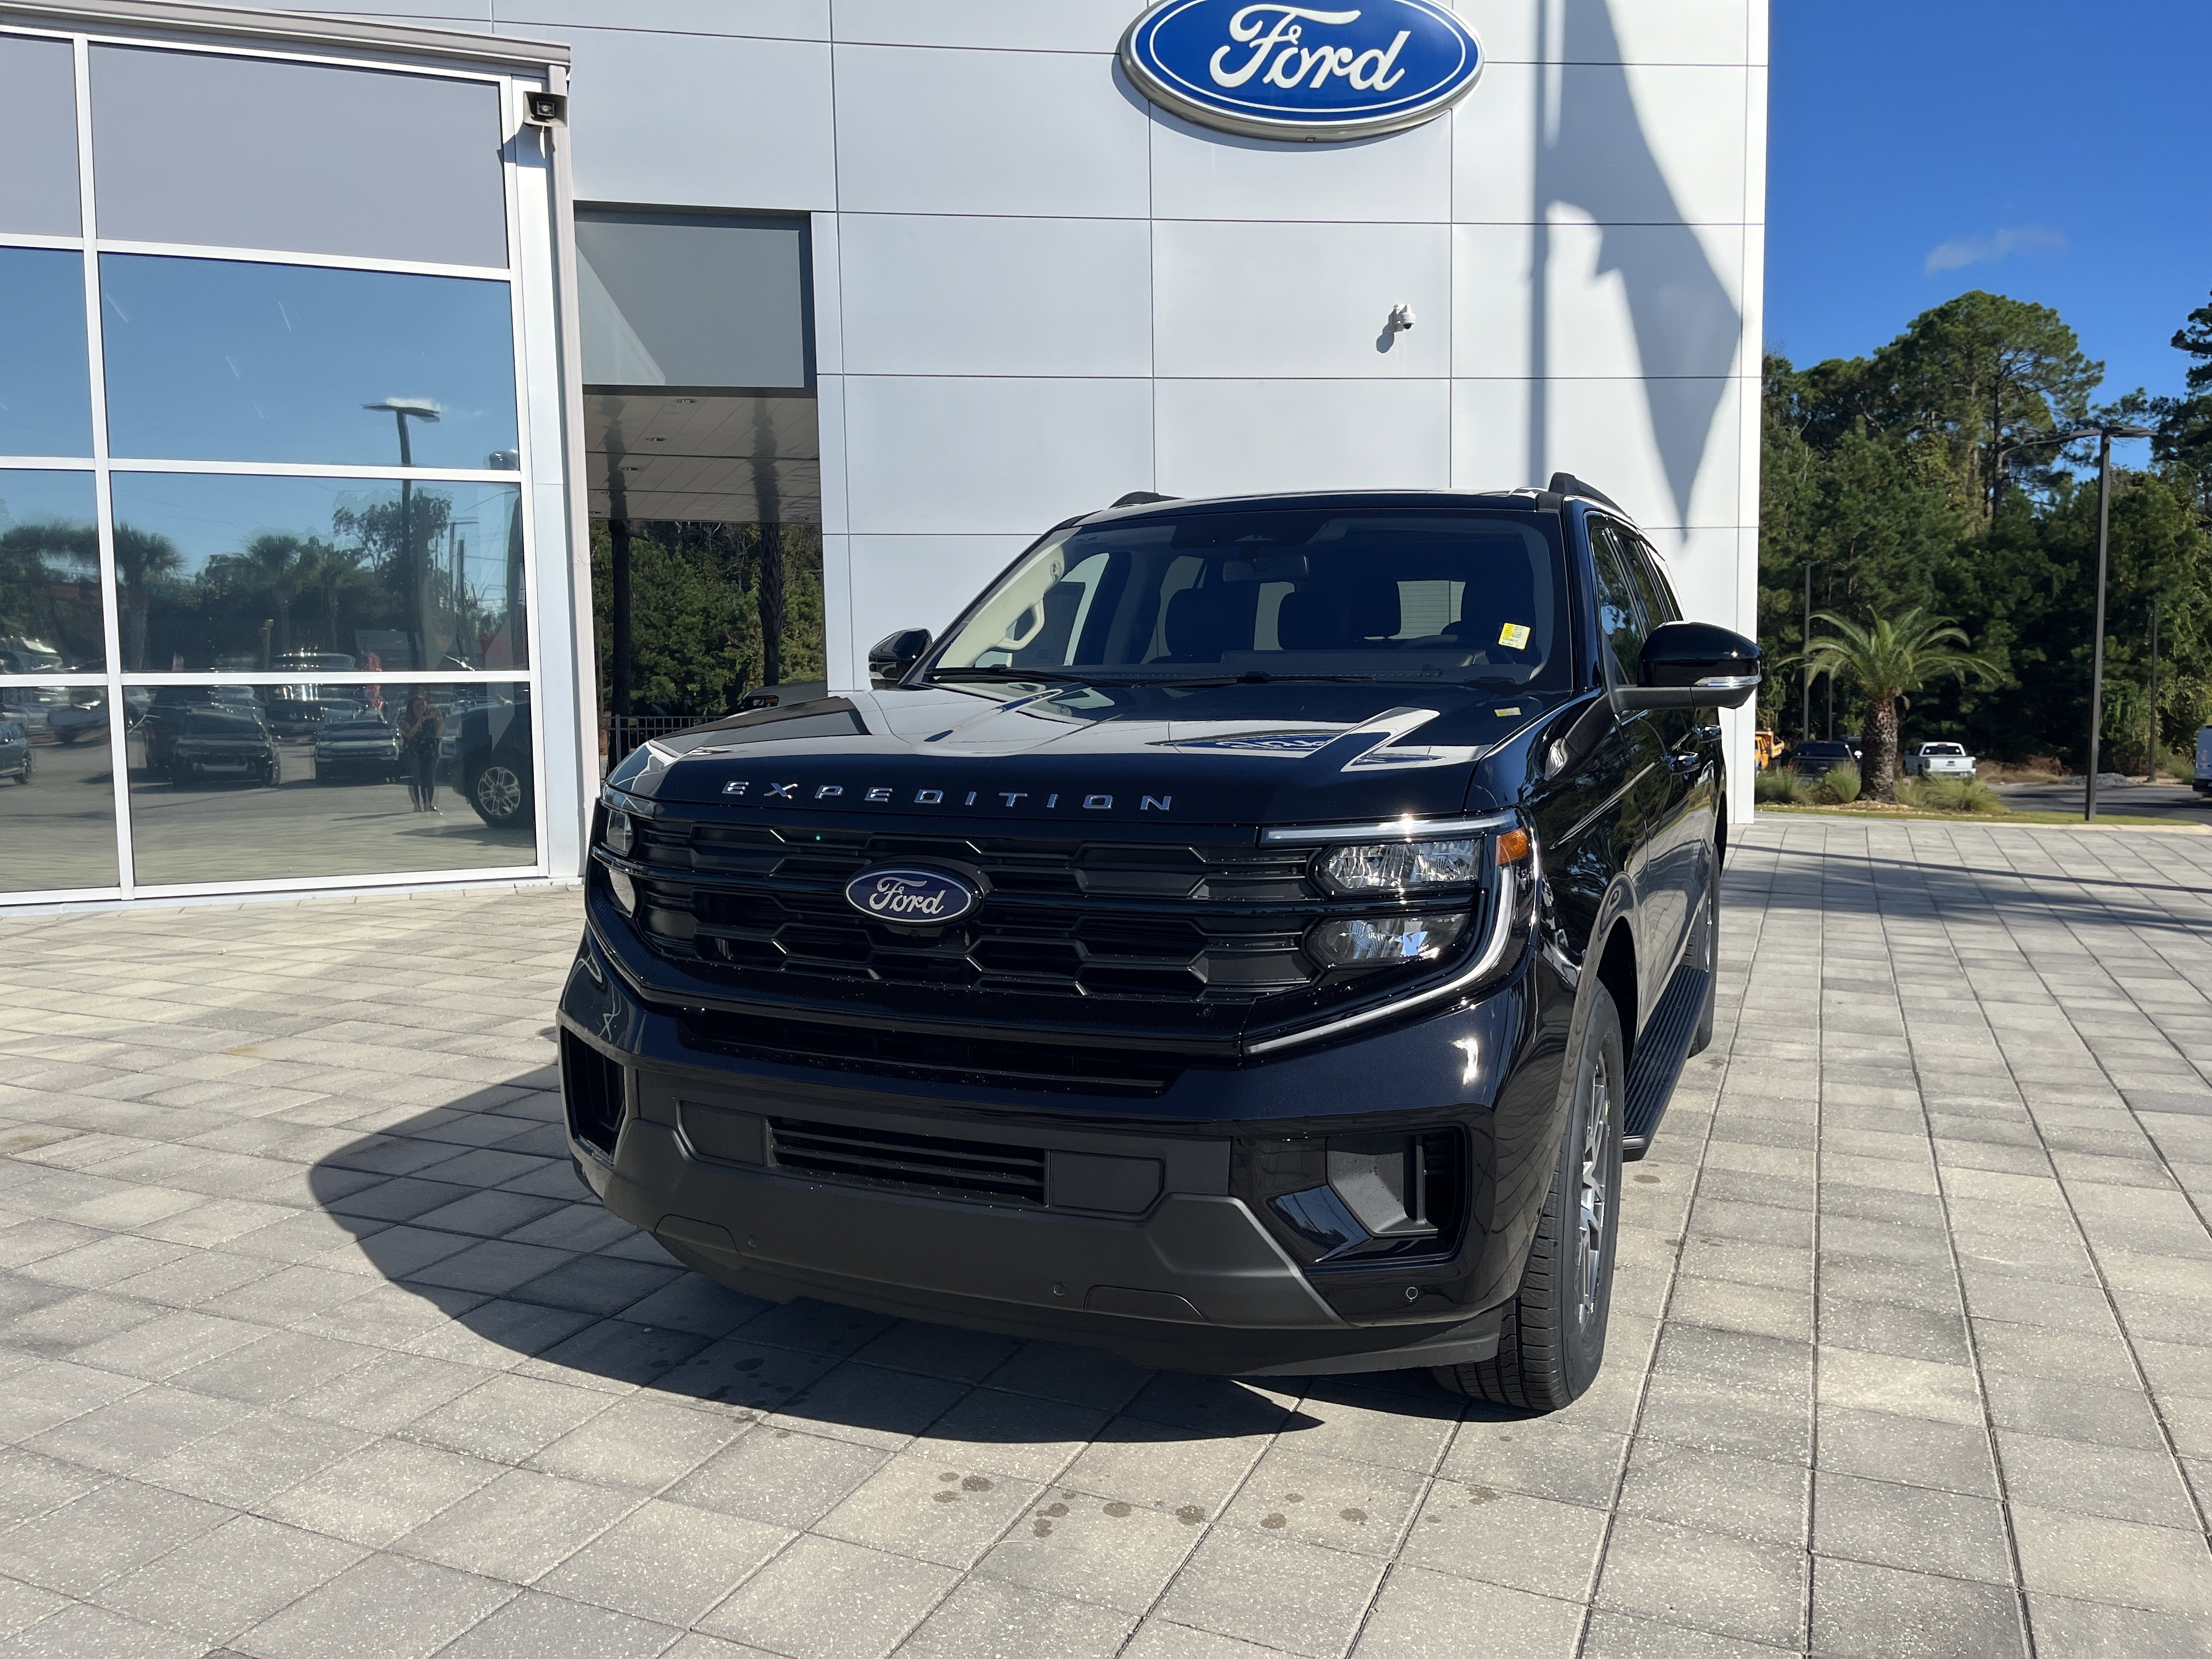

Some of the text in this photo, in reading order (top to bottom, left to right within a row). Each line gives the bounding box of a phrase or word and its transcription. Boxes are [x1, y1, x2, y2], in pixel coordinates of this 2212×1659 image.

[1209, 4, 1411, 92] Ford
[721, 780, 1172, 812] EXPEDITION
[869, 876, 947, 915] Ford
